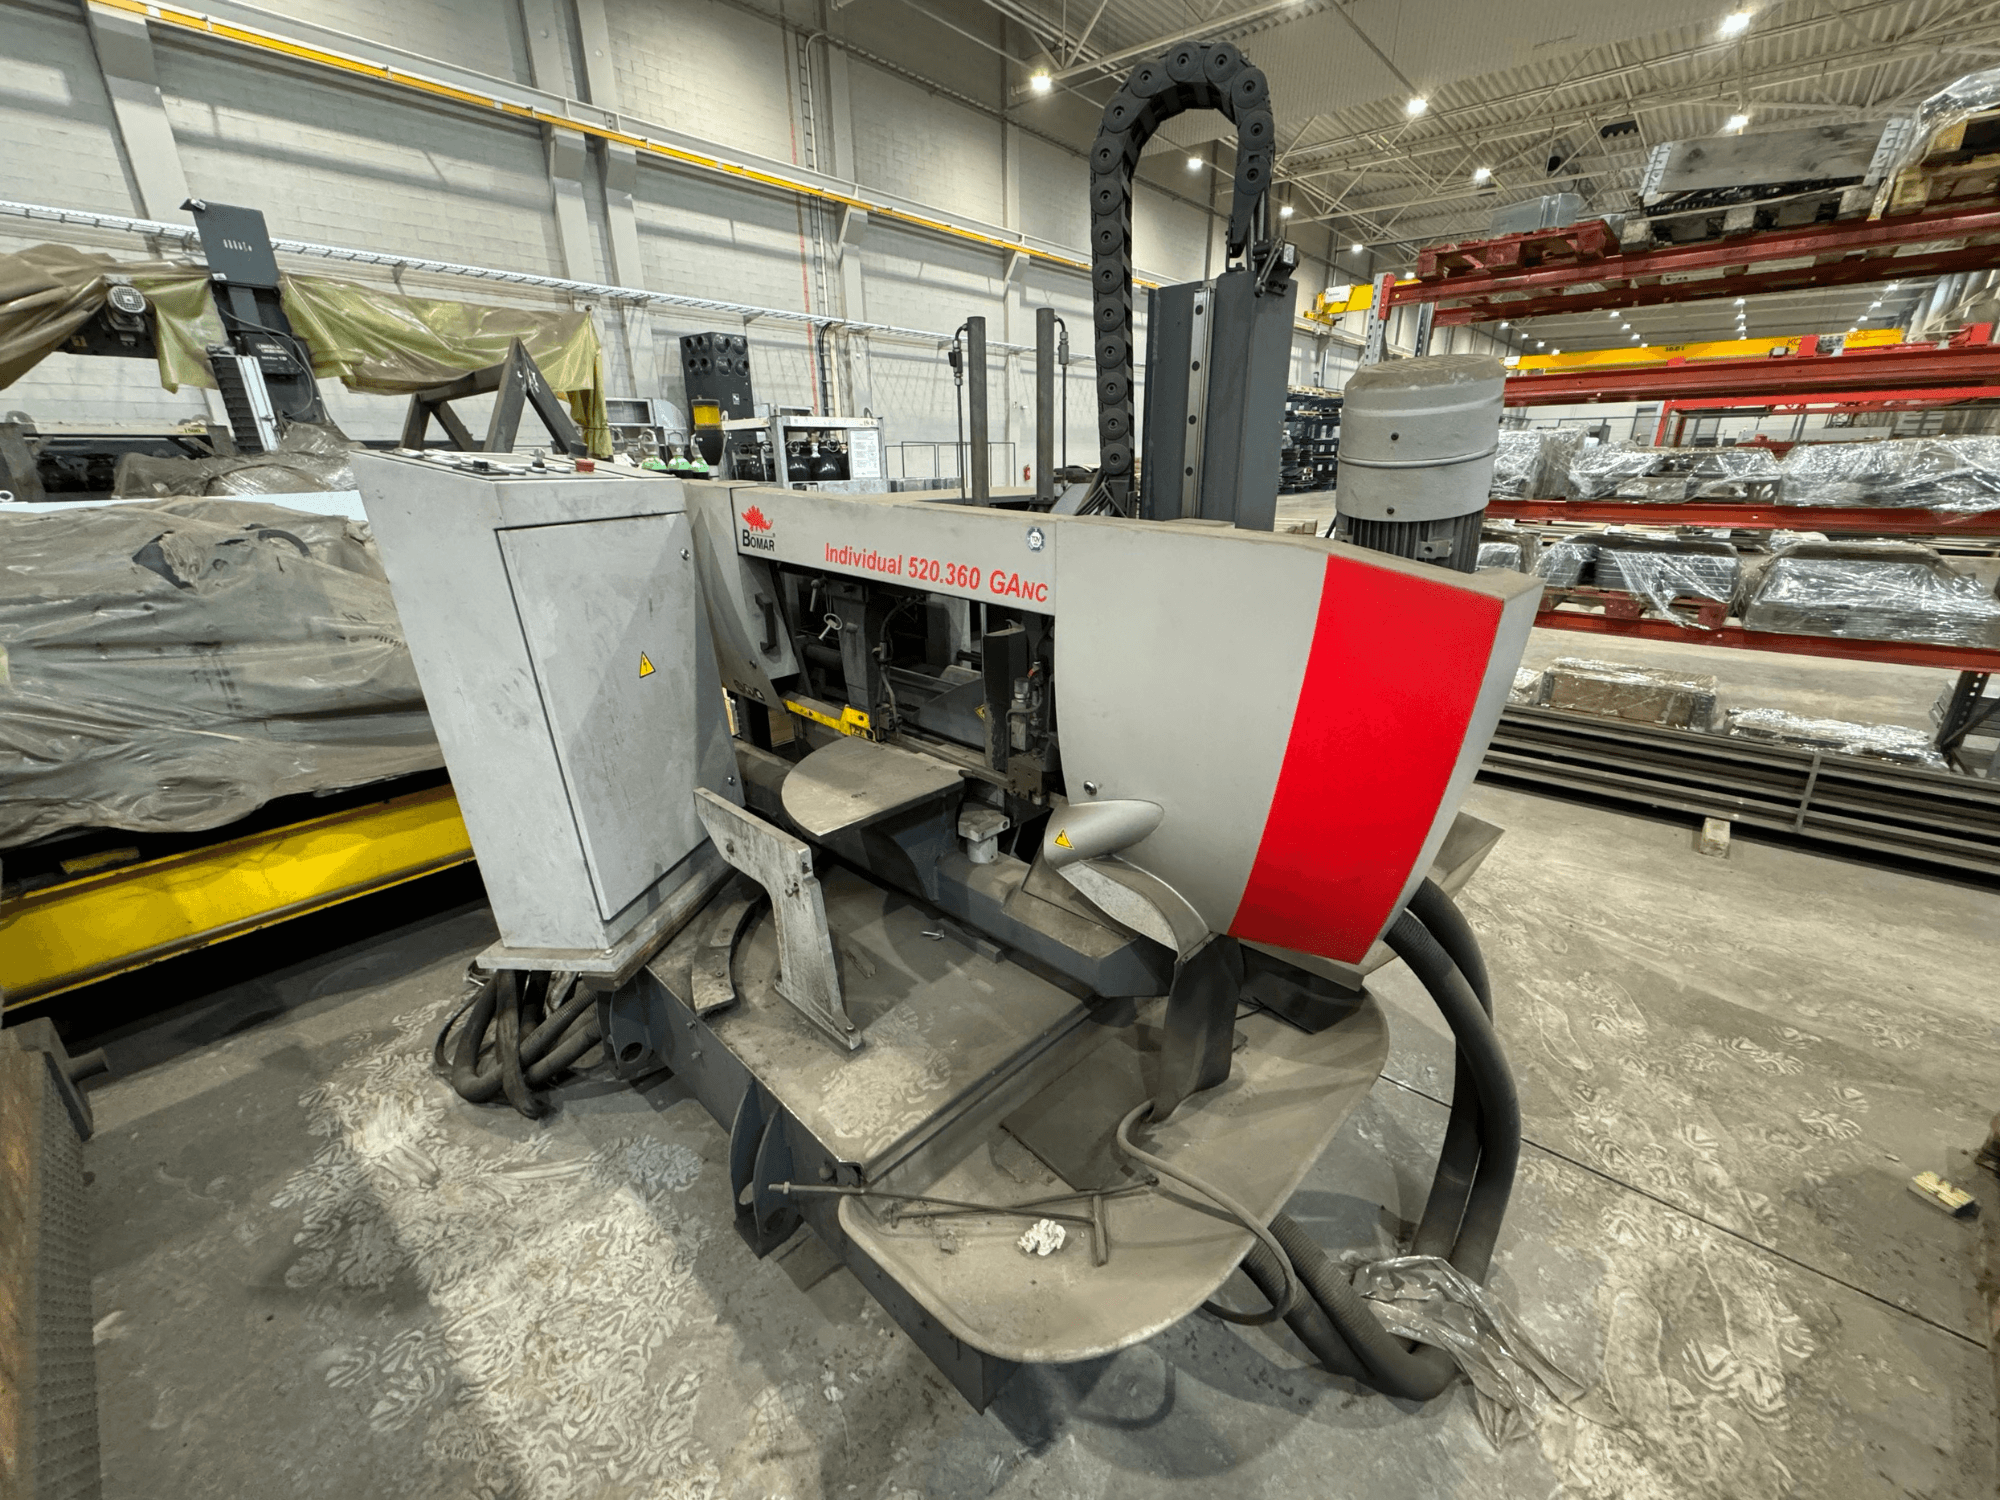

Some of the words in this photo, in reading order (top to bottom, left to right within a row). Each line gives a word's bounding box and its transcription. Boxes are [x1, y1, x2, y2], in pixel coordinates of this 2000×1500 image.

[742, 529, 775, 551] BOMAR
[825, 543, 902, 575] Individual
[908, 556, 981, 590] 520.360
